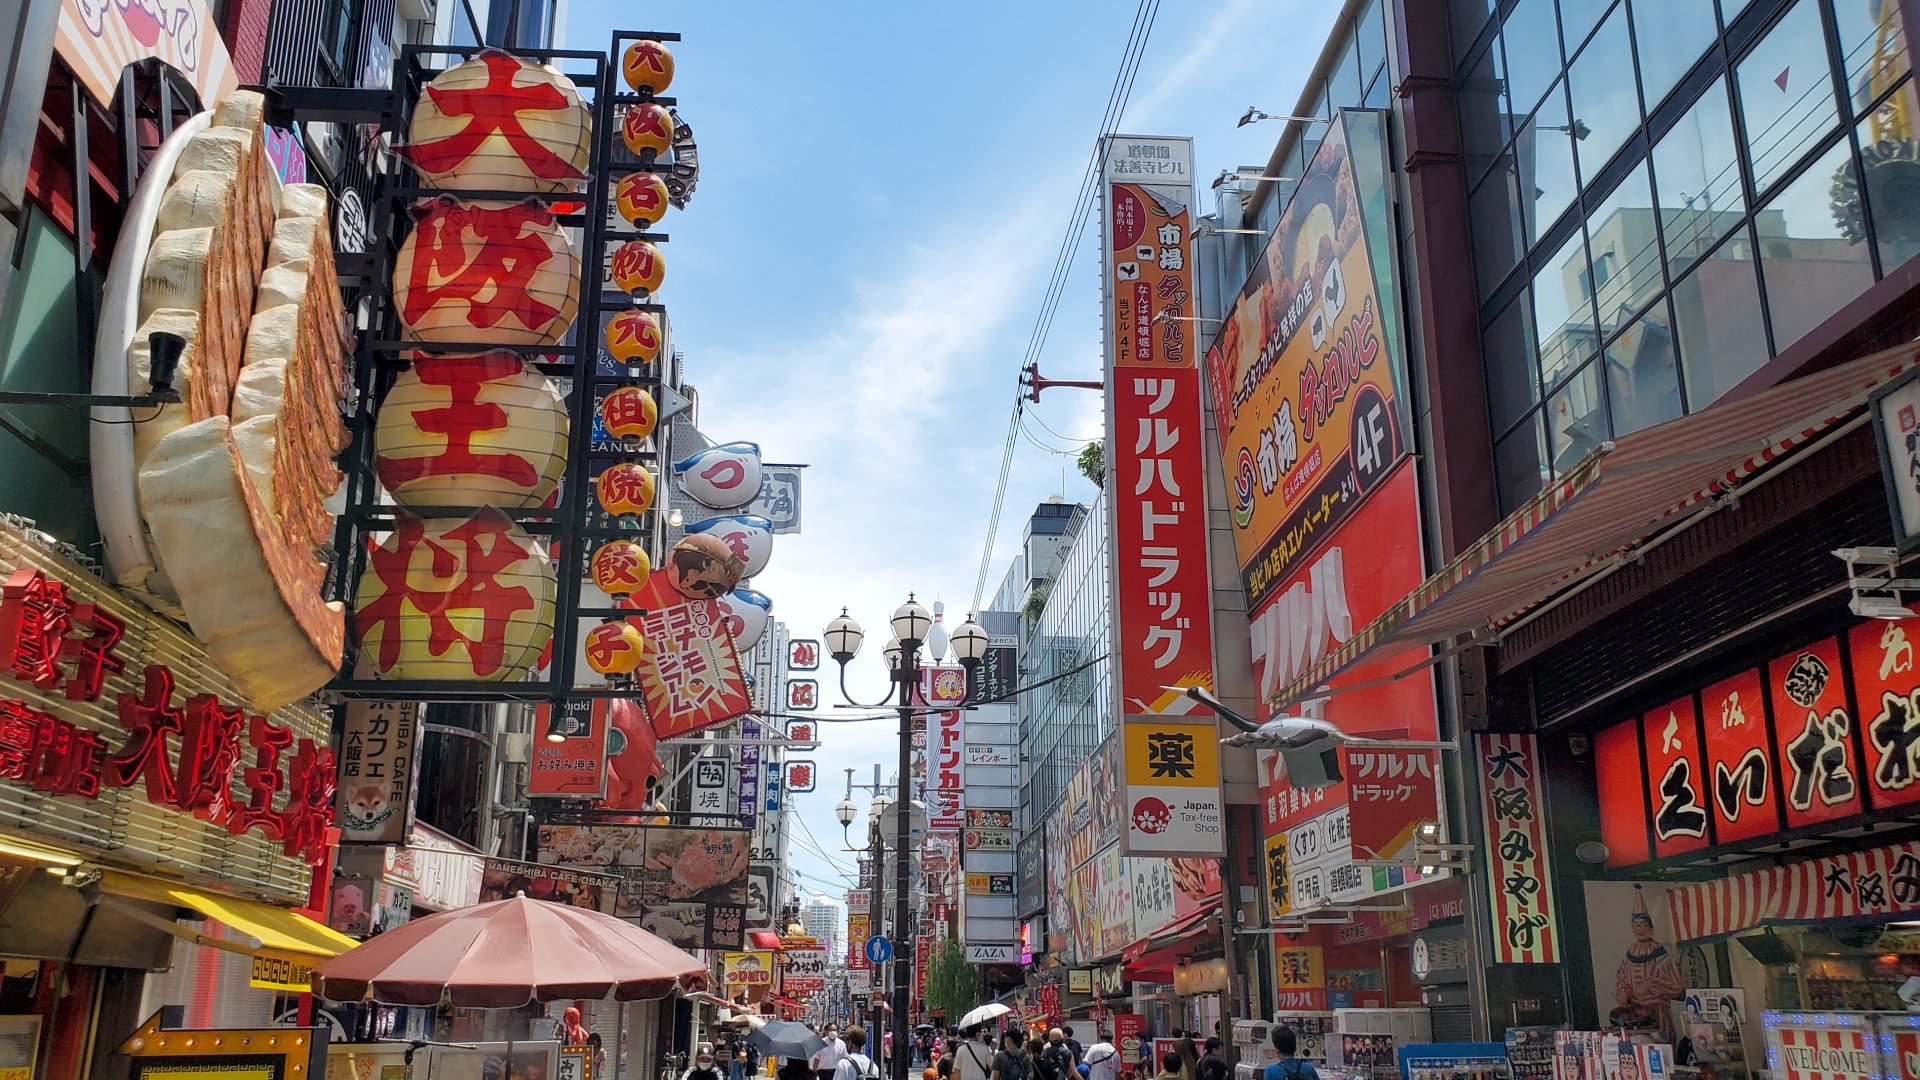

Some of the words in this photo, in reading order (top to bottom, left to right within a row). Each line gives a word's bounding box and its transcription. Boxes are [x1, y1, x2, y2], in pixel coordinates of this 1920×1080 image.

[1127, 144, 1170, 159] 道頓堀
[1113, 160, 1185, 175] 法善寺ビル
[1125, 197, 1134, 240] 韓国本場より
[1118, 298, 1130, 330] 当ビル
[1136, 284, 1150, 358] なんば道頓堀店
[353, 50, 590, 678] 大阪王将
[1231, 278, 1314, 420] チーズタッカルビ発祥の店
[1255, 401, 1299, 497] 市場
[1298, 296, 1380, 444] タッカルビ
[1356, 402, 1386, 477] 4F
[1283, 450, 1323, 504] なんば道頓堀店
[1132, 377, 1191, 670] ツルハドラッグ
[975, 665, 987, 701] コミック
[988, 648, 999, 700] インターネット
[344, 730, 365, 777] 大阪店
[536, 759, 597, 772] お好み焼き
[972, 754, 1008, 763] レインボー
[1147, 732, 1195, 779] 薬
[1349, 753, 1432, 779] ツルハ
[390, 756, 407, 803] CAFE
[1352, 784, 1417, 802] ドラッグ
[1180, 812, 1219, 823] Tax-free
[1183, 800, 1218, 811] Japan.
[1194, 823, 1219, 834] Shop
[1293, 830, 1317, 857] くすり
[1487, 746, 1548, 949] 大阪みやげ
[487, 862, 548, 880] MAMESHIBA
[550, 871, 579, 882] CAFE
[580, 876, 616, 889] OSAKA
[1268, 843, 1289, 907] 薬
[1296, 874, 1321, 903] 日用品
[1329, 864, 1362, 894] 道頓堀店
[1101, 879, 1131, 924] レインボー
[782, 951, 824, 975] わなか
[974, 948, 1006, 958] ZAZA
[1281, 951, 1310, 984] 薬
[726, 970, 770, 983] つりぼり
[1279, 991, 1313, 1008] ツルハ
[1785, 1047, 1869, 1075] WELCOME
